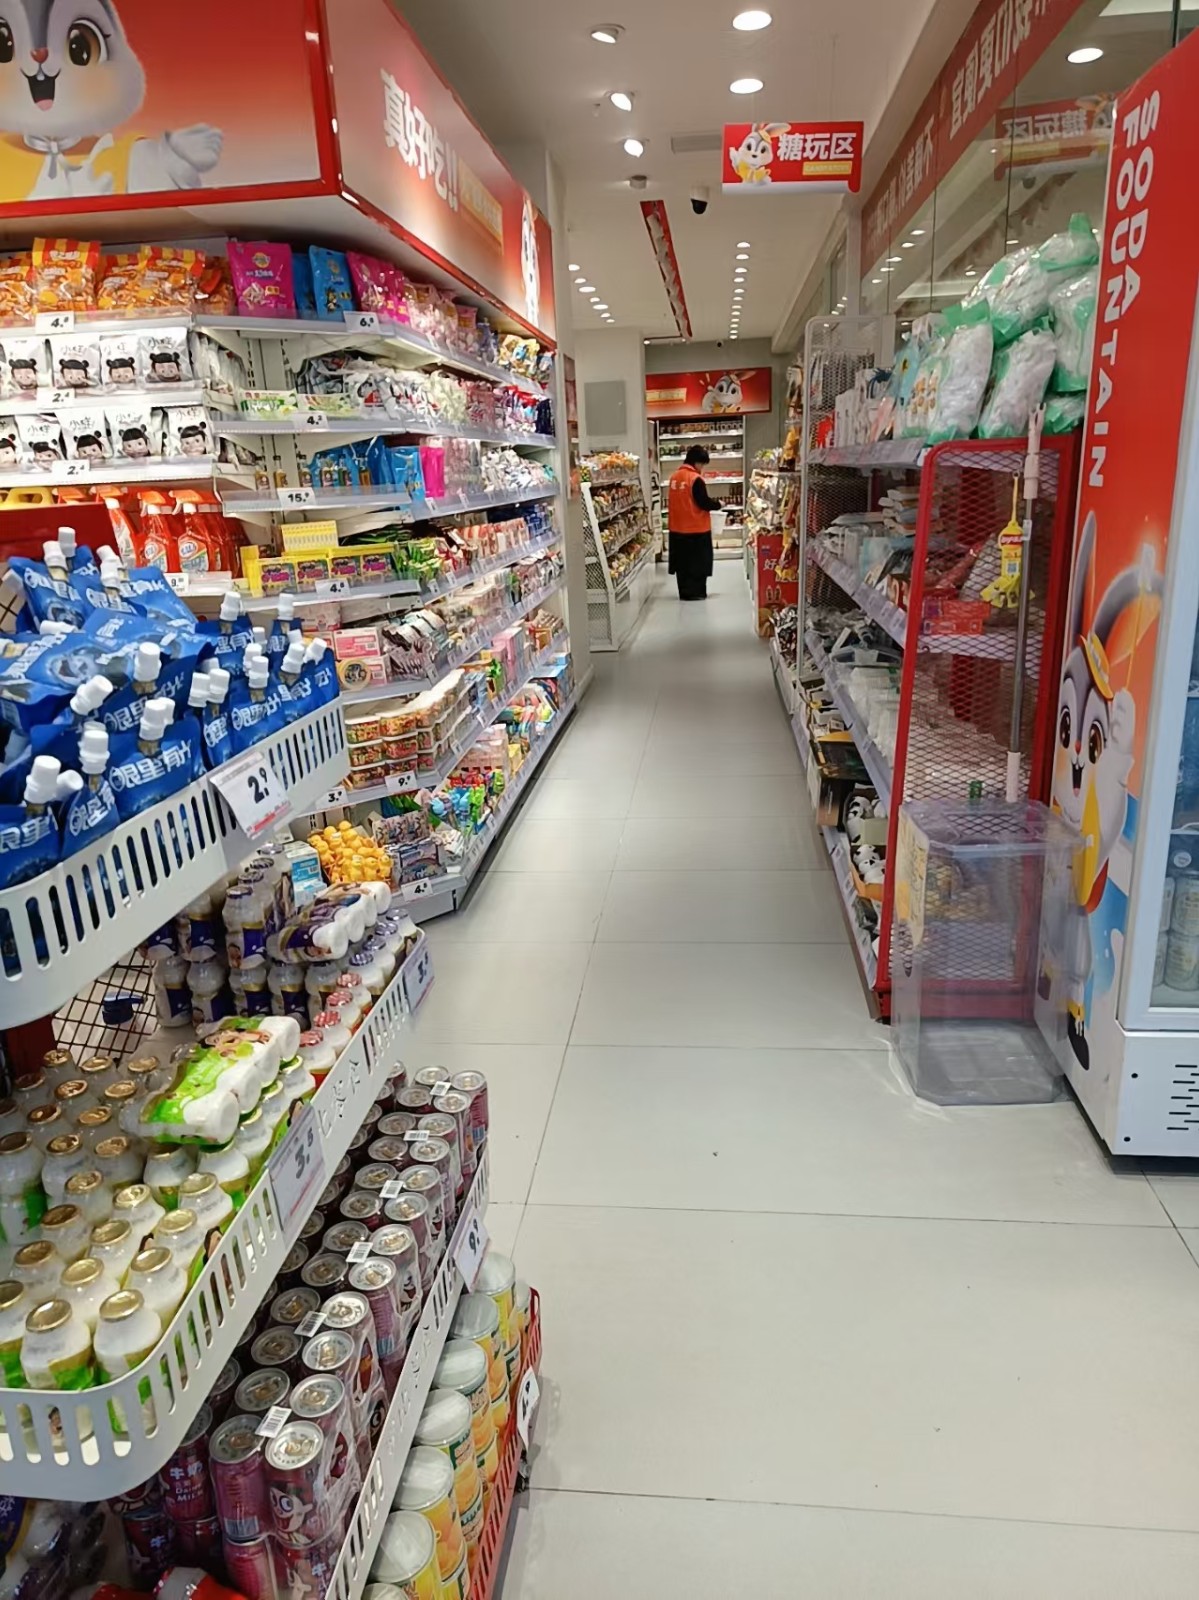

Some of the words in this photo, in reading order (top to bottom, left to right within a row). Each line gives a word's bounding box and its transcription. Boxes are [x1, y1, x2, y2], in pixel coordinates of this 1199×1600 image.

[777, 132, 857, 161] 糖玩区
[1121, 90, 1160, 316] SODA
[1088, 105, 1142, 487] FOUNTAIN
[248, 767, 270, 804] 2.9
[295, 1130, 314, 1179] 3.5
